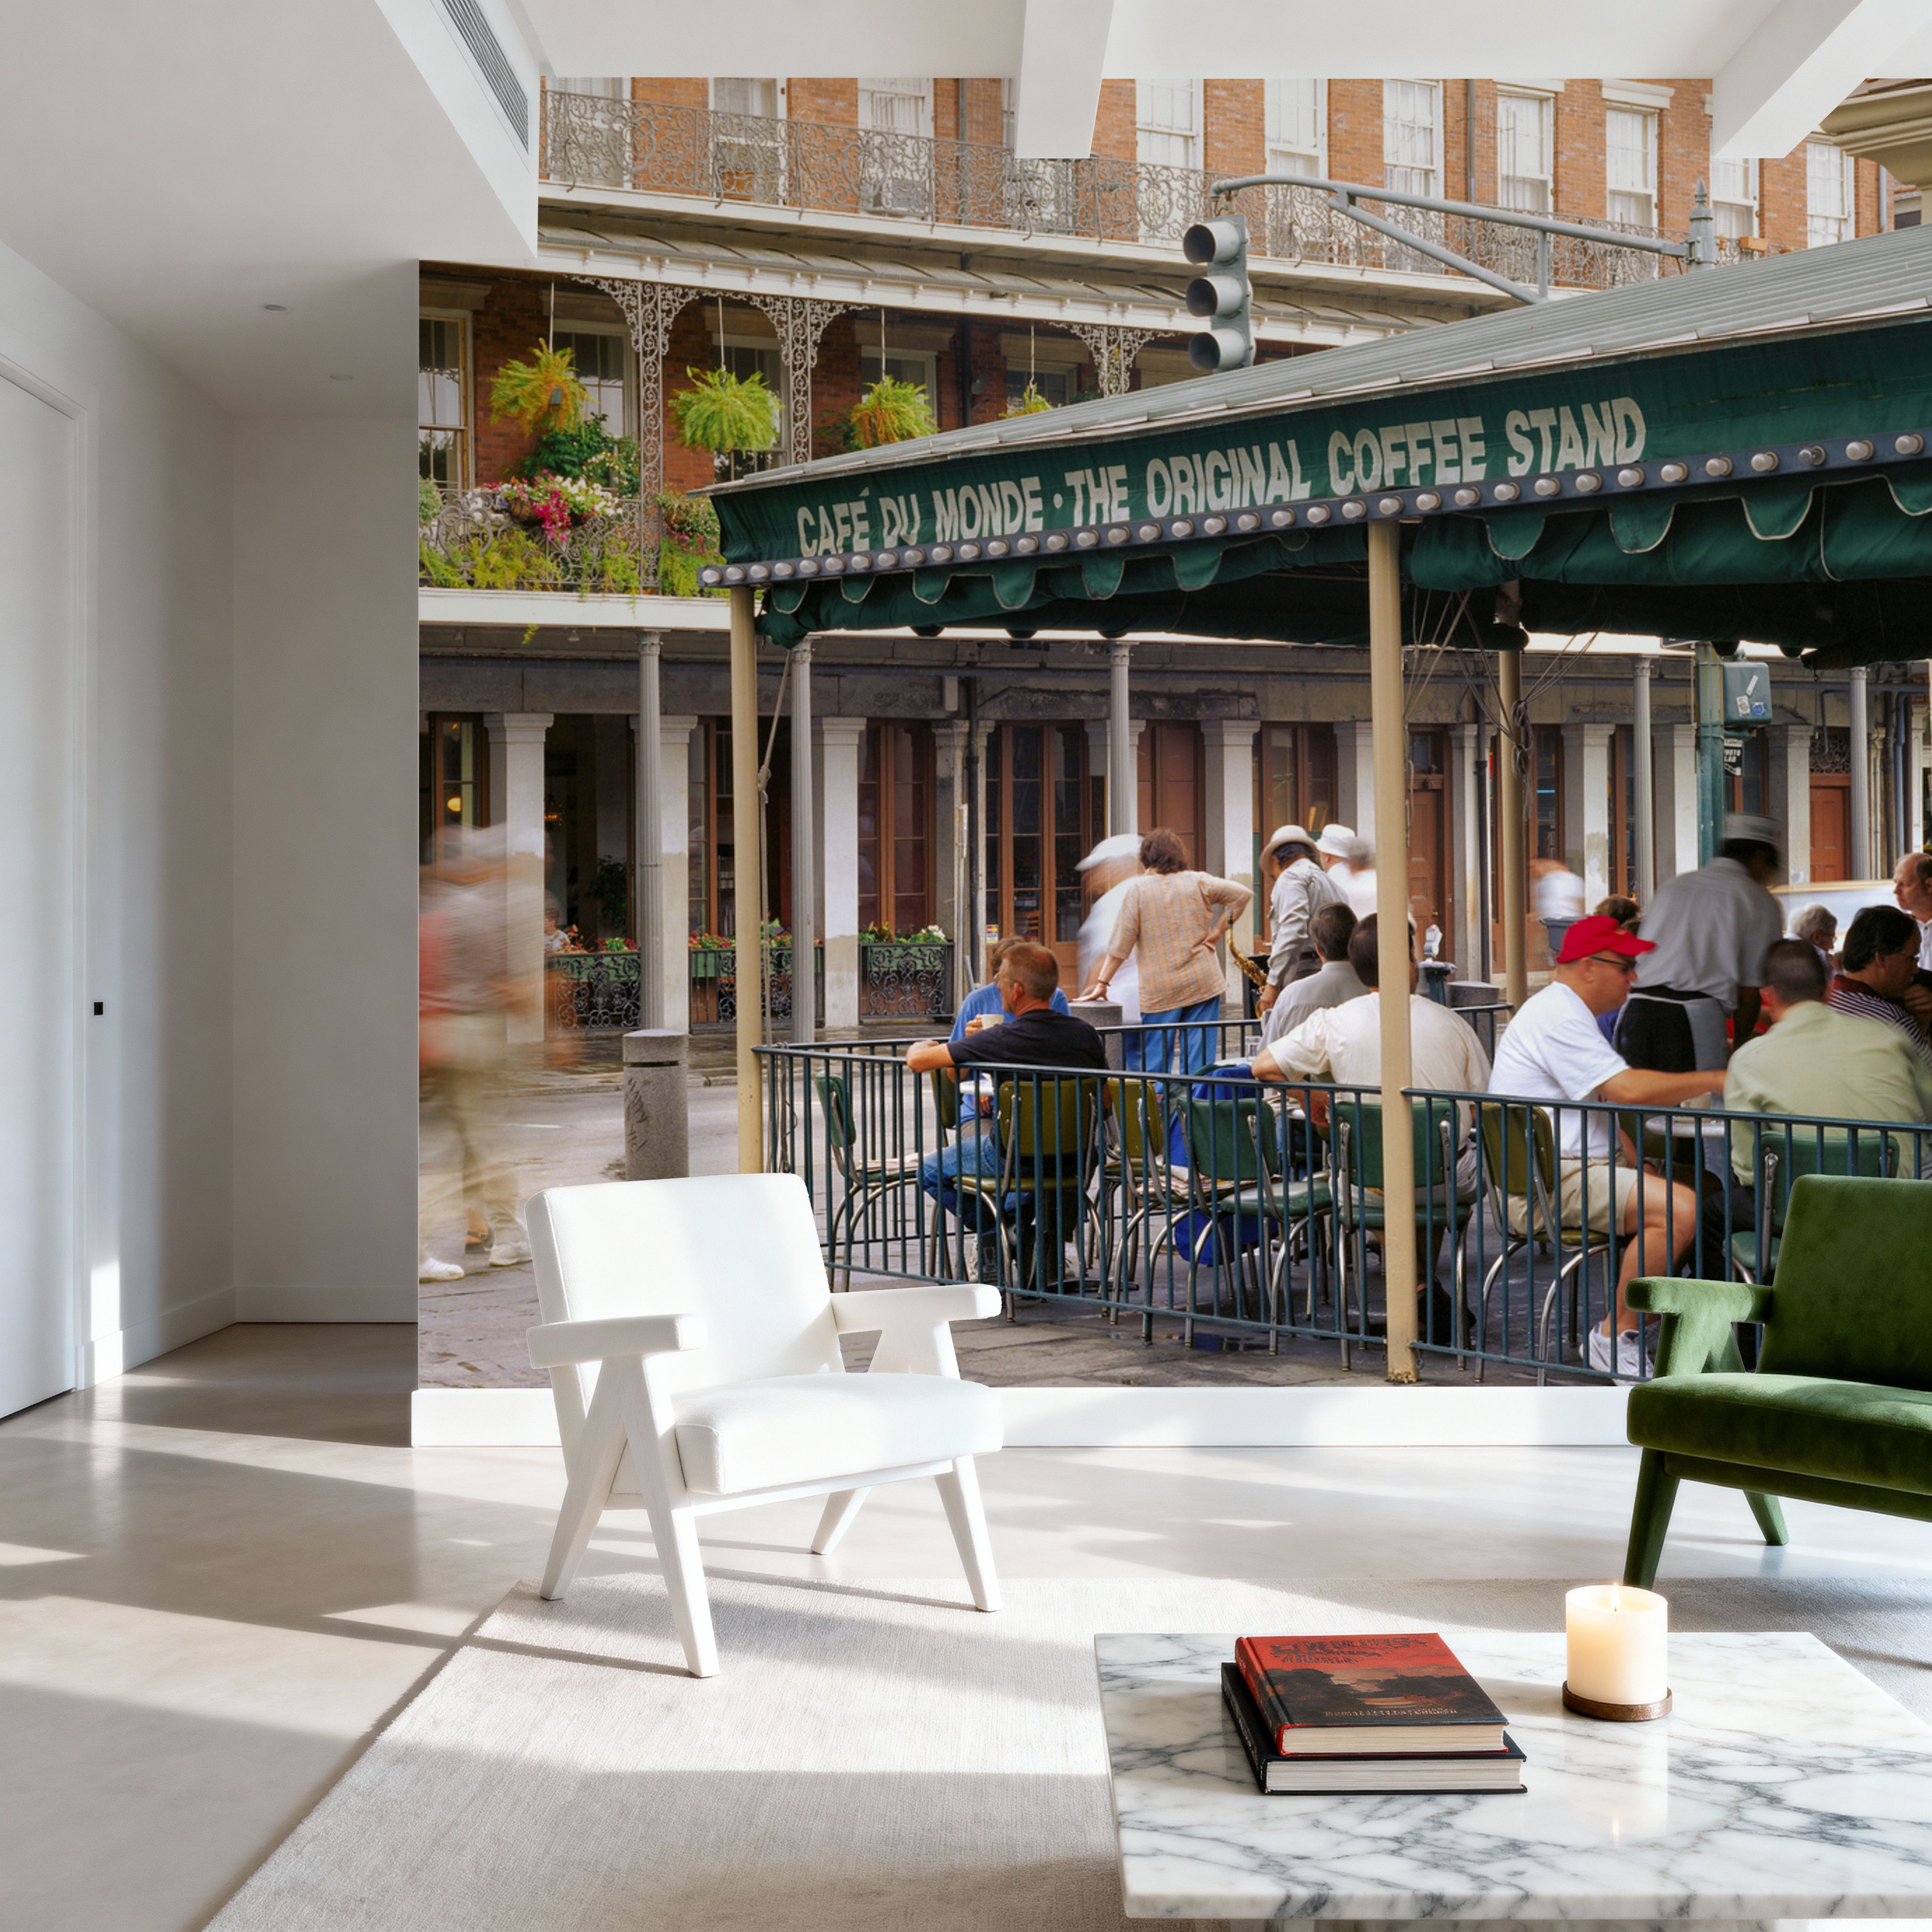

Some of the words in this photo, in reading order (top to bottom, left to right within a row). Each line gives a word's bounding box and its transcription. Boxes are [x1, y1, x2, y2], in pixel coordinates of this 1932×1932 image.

[797, 487, 870, 558] CAFÉ
[879, 493, 921, 549] DU
[932, 476, 1043, 543] MONDE
[1065, 465, 1130, 528] THE
[1147, 440, 1311, 519] ORIGINAL
[1328, 416, 1487, 496] COFFEE
[1505, 397, 1647, 477] STAND
